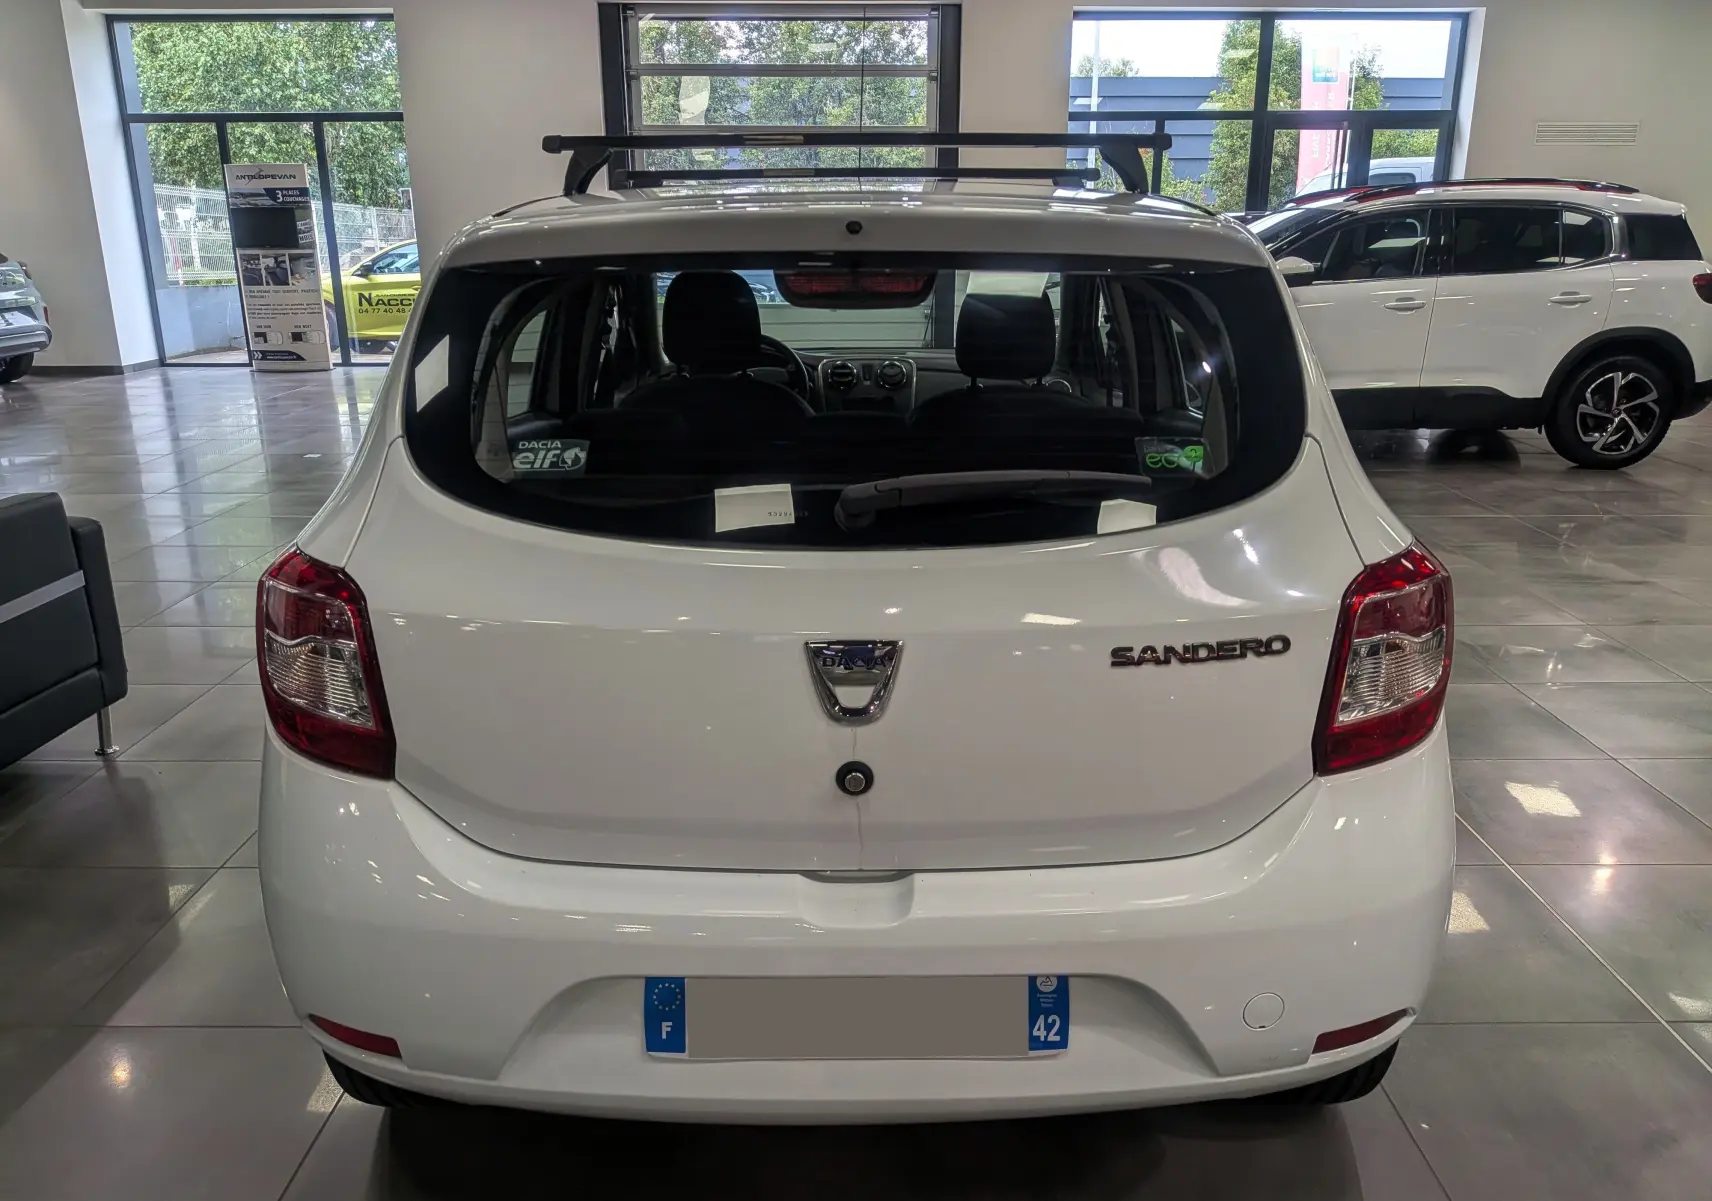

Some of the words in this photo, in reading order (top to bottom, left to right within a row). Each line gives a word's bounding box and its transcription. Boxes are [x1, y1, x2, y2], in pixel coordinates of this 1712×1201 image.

[275, 190, 283, 202] 3
[518, 440, 562, 449] DACIA
[513, 449, 561, 469] elf
[1110, 634, 1291, 668] SANDERO
[661, 1021, 673, 1040] F
[1032, 1014, 1061, 1042] 42
